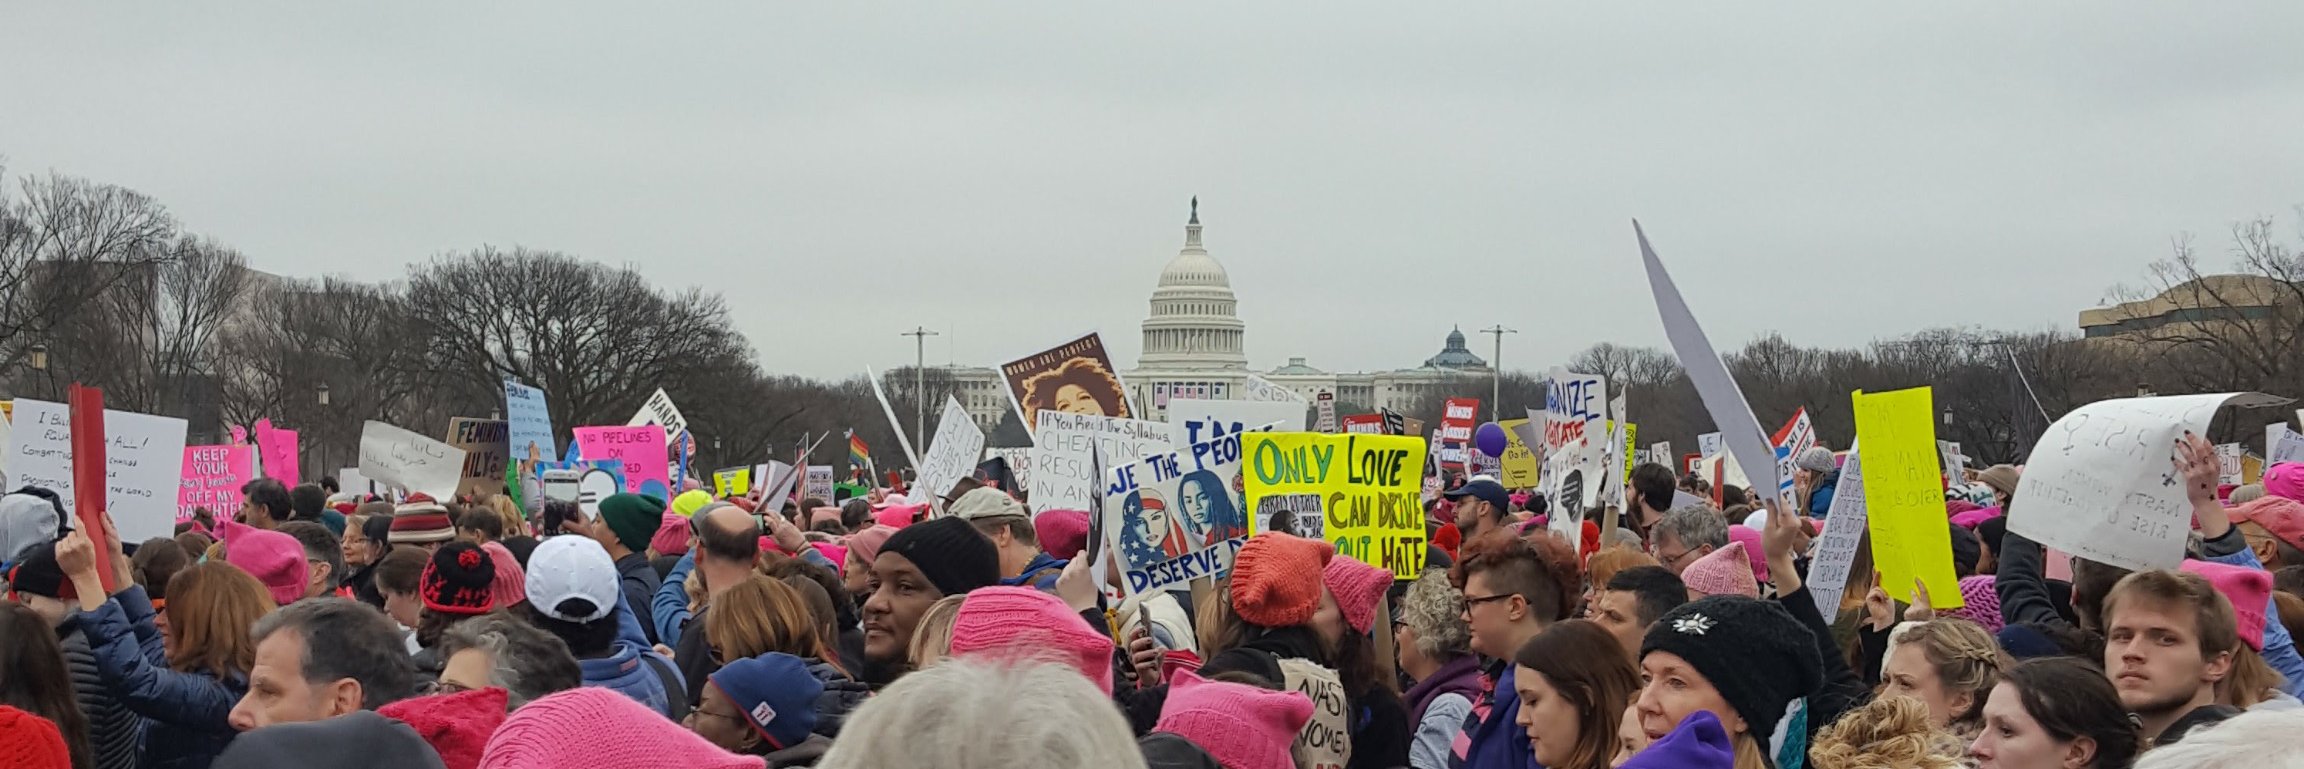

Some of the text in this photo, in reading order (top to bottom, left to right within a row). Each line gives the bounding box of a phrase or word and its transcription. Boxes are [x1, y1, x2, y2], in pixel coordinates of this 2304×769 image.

[648, 393, 681, 435] HANDS
[602, 432, 651, 445] PIPELINES
[1123, 422, 1171, 444] Syllabus
[193, 448, 229, 462] KEEP
[193, 462, 229, 475] YOUR
[1254, 438, 1334, 486] ONLY
[1348, 436, 1408, 487] LOVE
[1106, 452, 1182, 496] WE THE
[186, 490, 235, 504] OFF MY
[1328, 491, 1423, 531] CAN DRIVE
[1127, 545, 1222, 595] DESERVE
